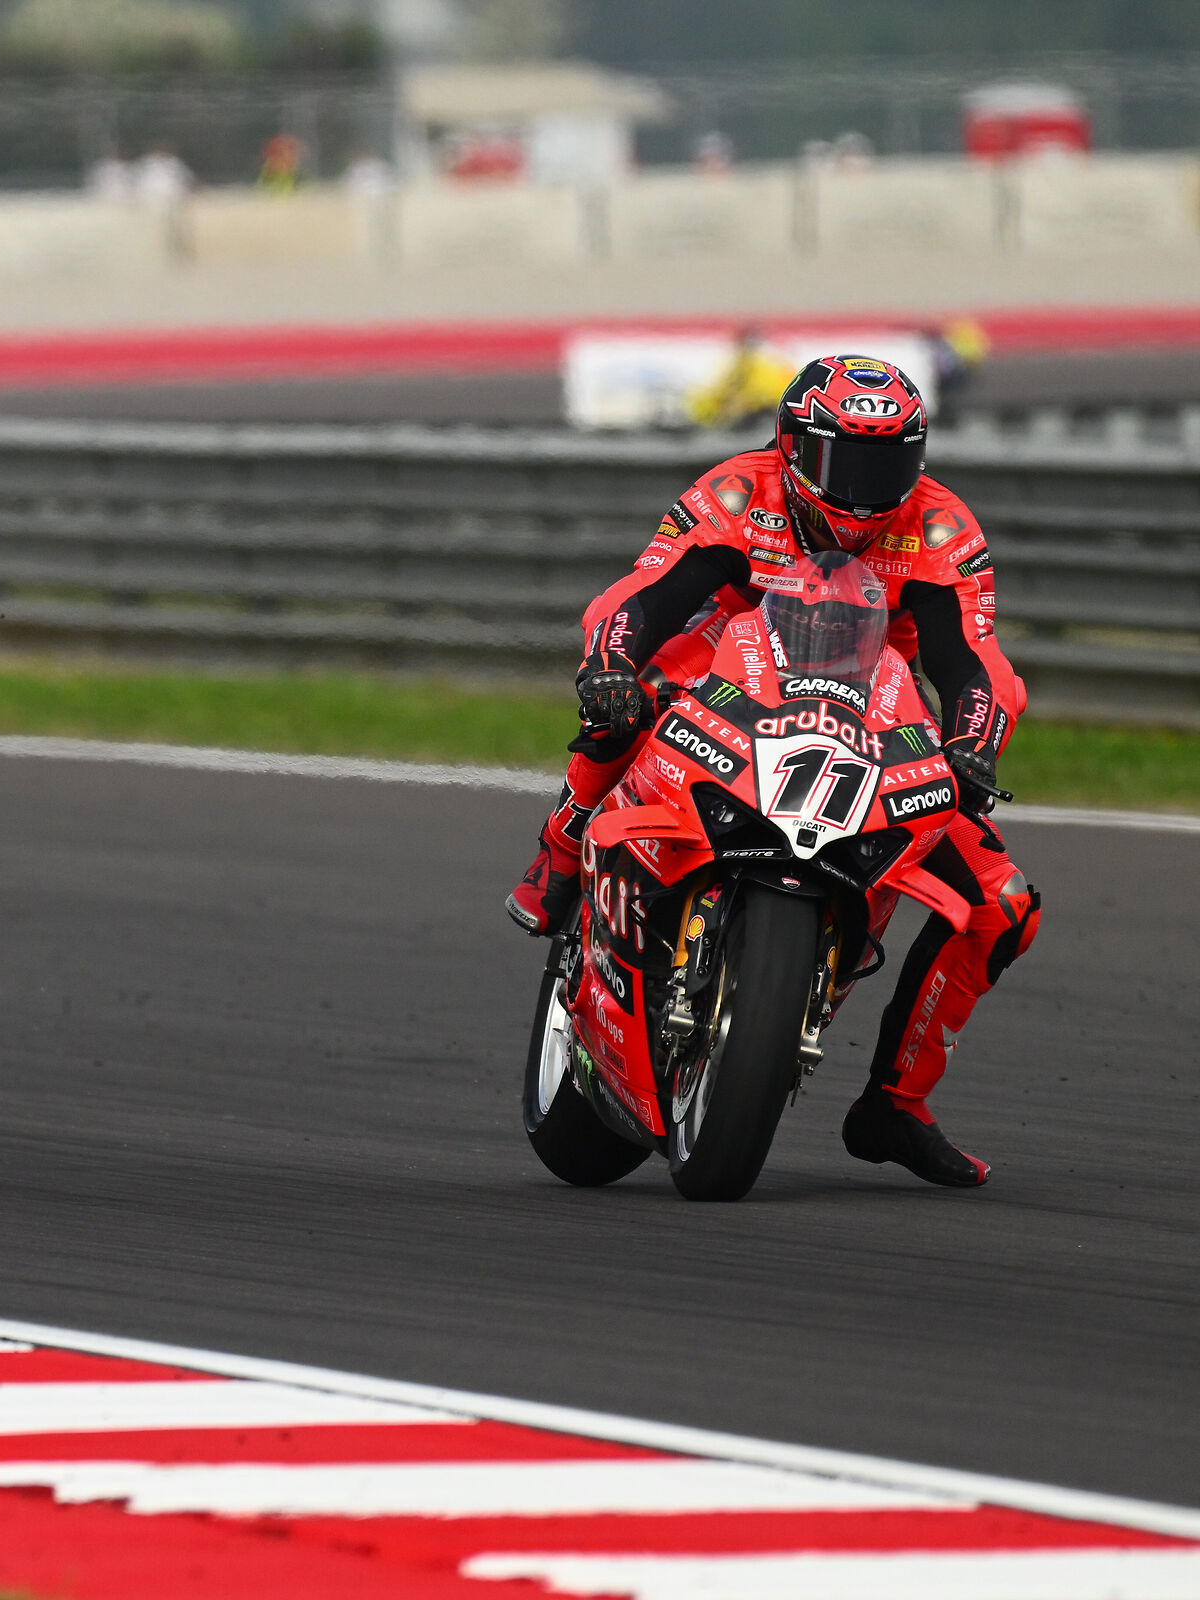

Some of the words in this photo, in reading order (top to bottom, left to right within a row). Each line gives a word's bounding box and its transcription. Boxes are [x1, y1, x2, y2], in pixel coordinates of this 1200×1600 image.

[847, 397, 896, 414] KYT
[807, 425, 836, 439] CARRERA
[868, 561, 909, 574] nesite
[740, 647, 767, 676] riello
[768, 630, 789, 668] WRS
[745, 677, 761, 695] ups
[786, 678, 866, 712] CARRERA
[876, 681, 899, 715] riello
[679, 700, 751, 751] ALTEN
[755, 701, 885, 760] aruba.it
[664, 718, 734, 773] Lenovo
[766, 744, 875, 831] 11
[883, 761, 948, 787] ALTEN
[889, 787, 951, 817] Lenovo
[792, 819, 827, 833] DUCATI
